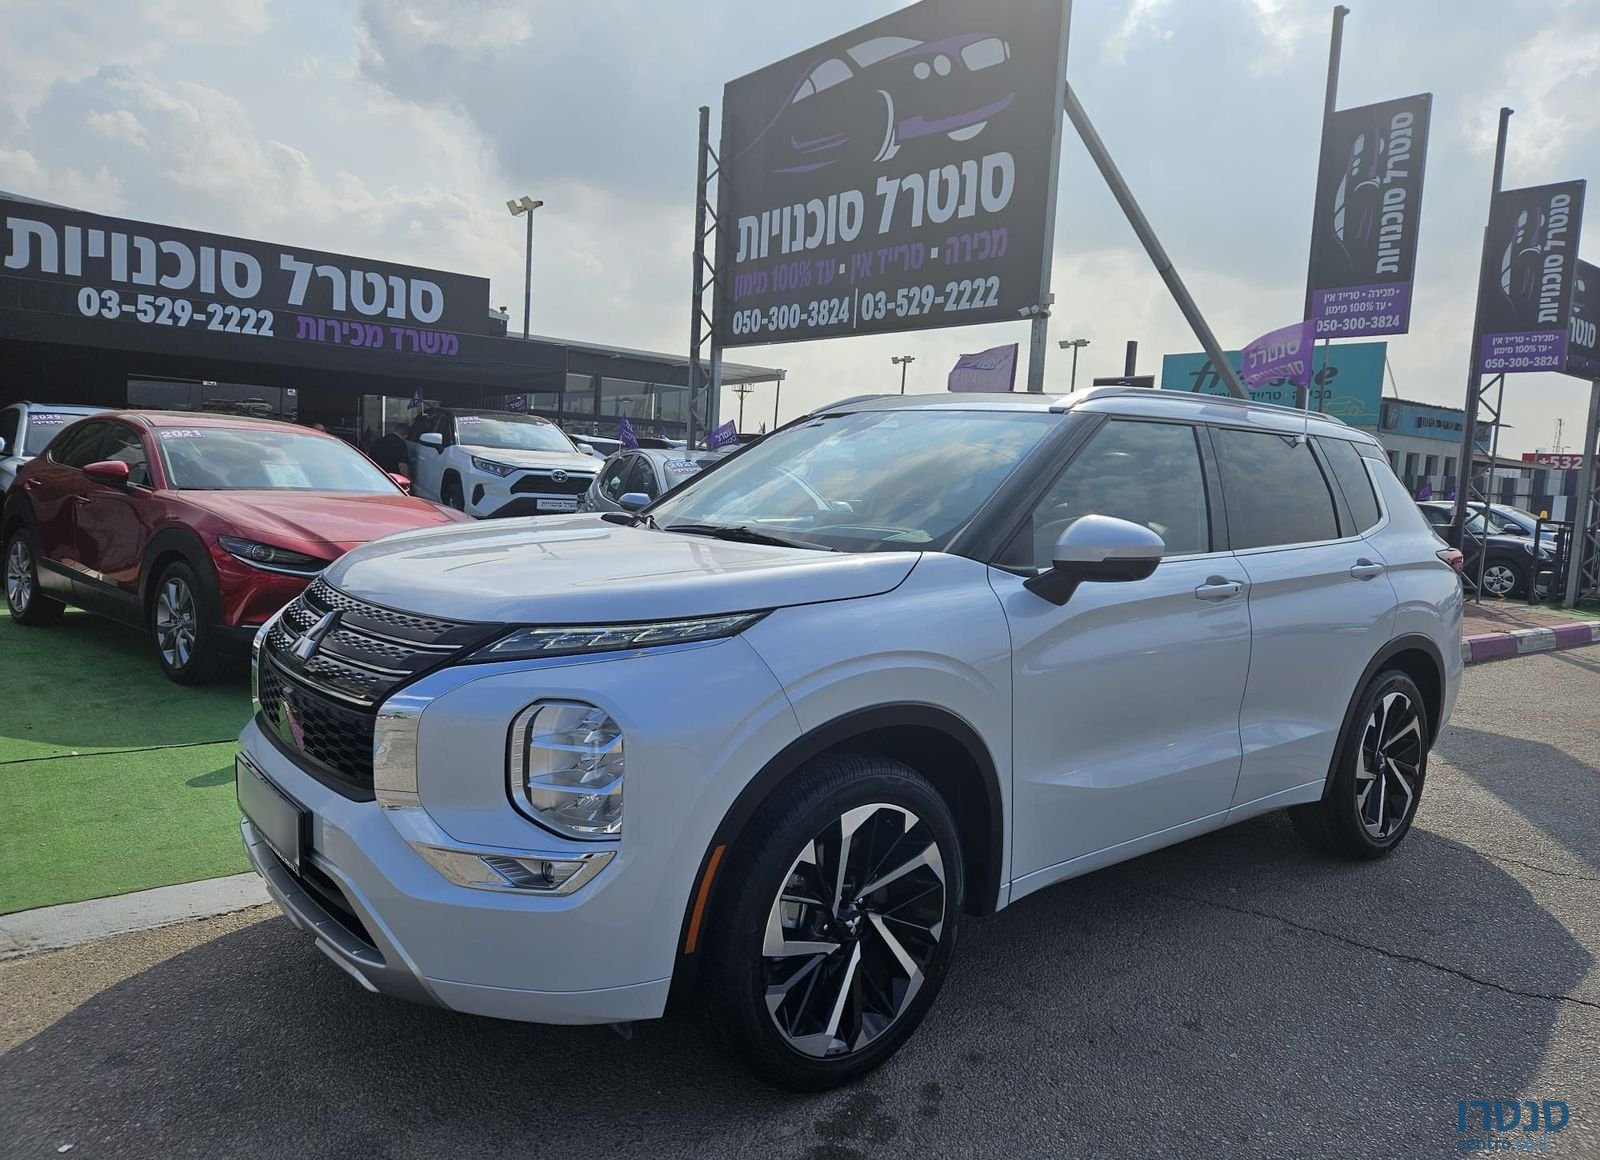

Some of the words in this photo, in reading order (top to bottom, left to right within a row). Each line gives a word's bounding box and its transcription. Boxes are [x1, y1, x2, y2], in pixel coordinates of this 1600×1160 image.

[1382, 111, 1414, 184] סנטרל
[876, 151, 1015, 234] סנטרל
[736, 189, 864, 263] סוכנויות
[1376, 187, 1406, 274] סוכנויות
[1544, 193, 1571, 250] סנטרל
[4, 216, 262, 299] סוכנויות
[877, 242, 925, 275] טרייד
[945, 228, 1008, 265] מכירה
[771, 259, 813, 292] 100%
[815, 258, 836, 285] עד
[850, 250, 872, 285] אין
[280, 253, 445, 324] סנטרל
[733, 268, 768, 301] מימון
[1323, 293, 1336, 304] אין
[1338, 291, 1360, 301] טרייד
[1368, 288, 1395, 298] מכירה
[1538, 254, 1564, 323] סוכנויות
[77, 286, 275, 338] 03-529-2222
[732, 296, 850, 336] 050-300-3824
[861, 275, 1001, 321] 03-529-2222
[1349, 302, 1374, 312] 100%
[1375, 301, 1386, 311] עד
[296, 315, 384, 348] מכירות
[1316, 315, 1400, 332] 050-300-3824
[390, 325, 459, 356] משרד
[1249, 340, 1301, 368] סנטרל
[1484, 355, 1559, 369] 050-300-3824
